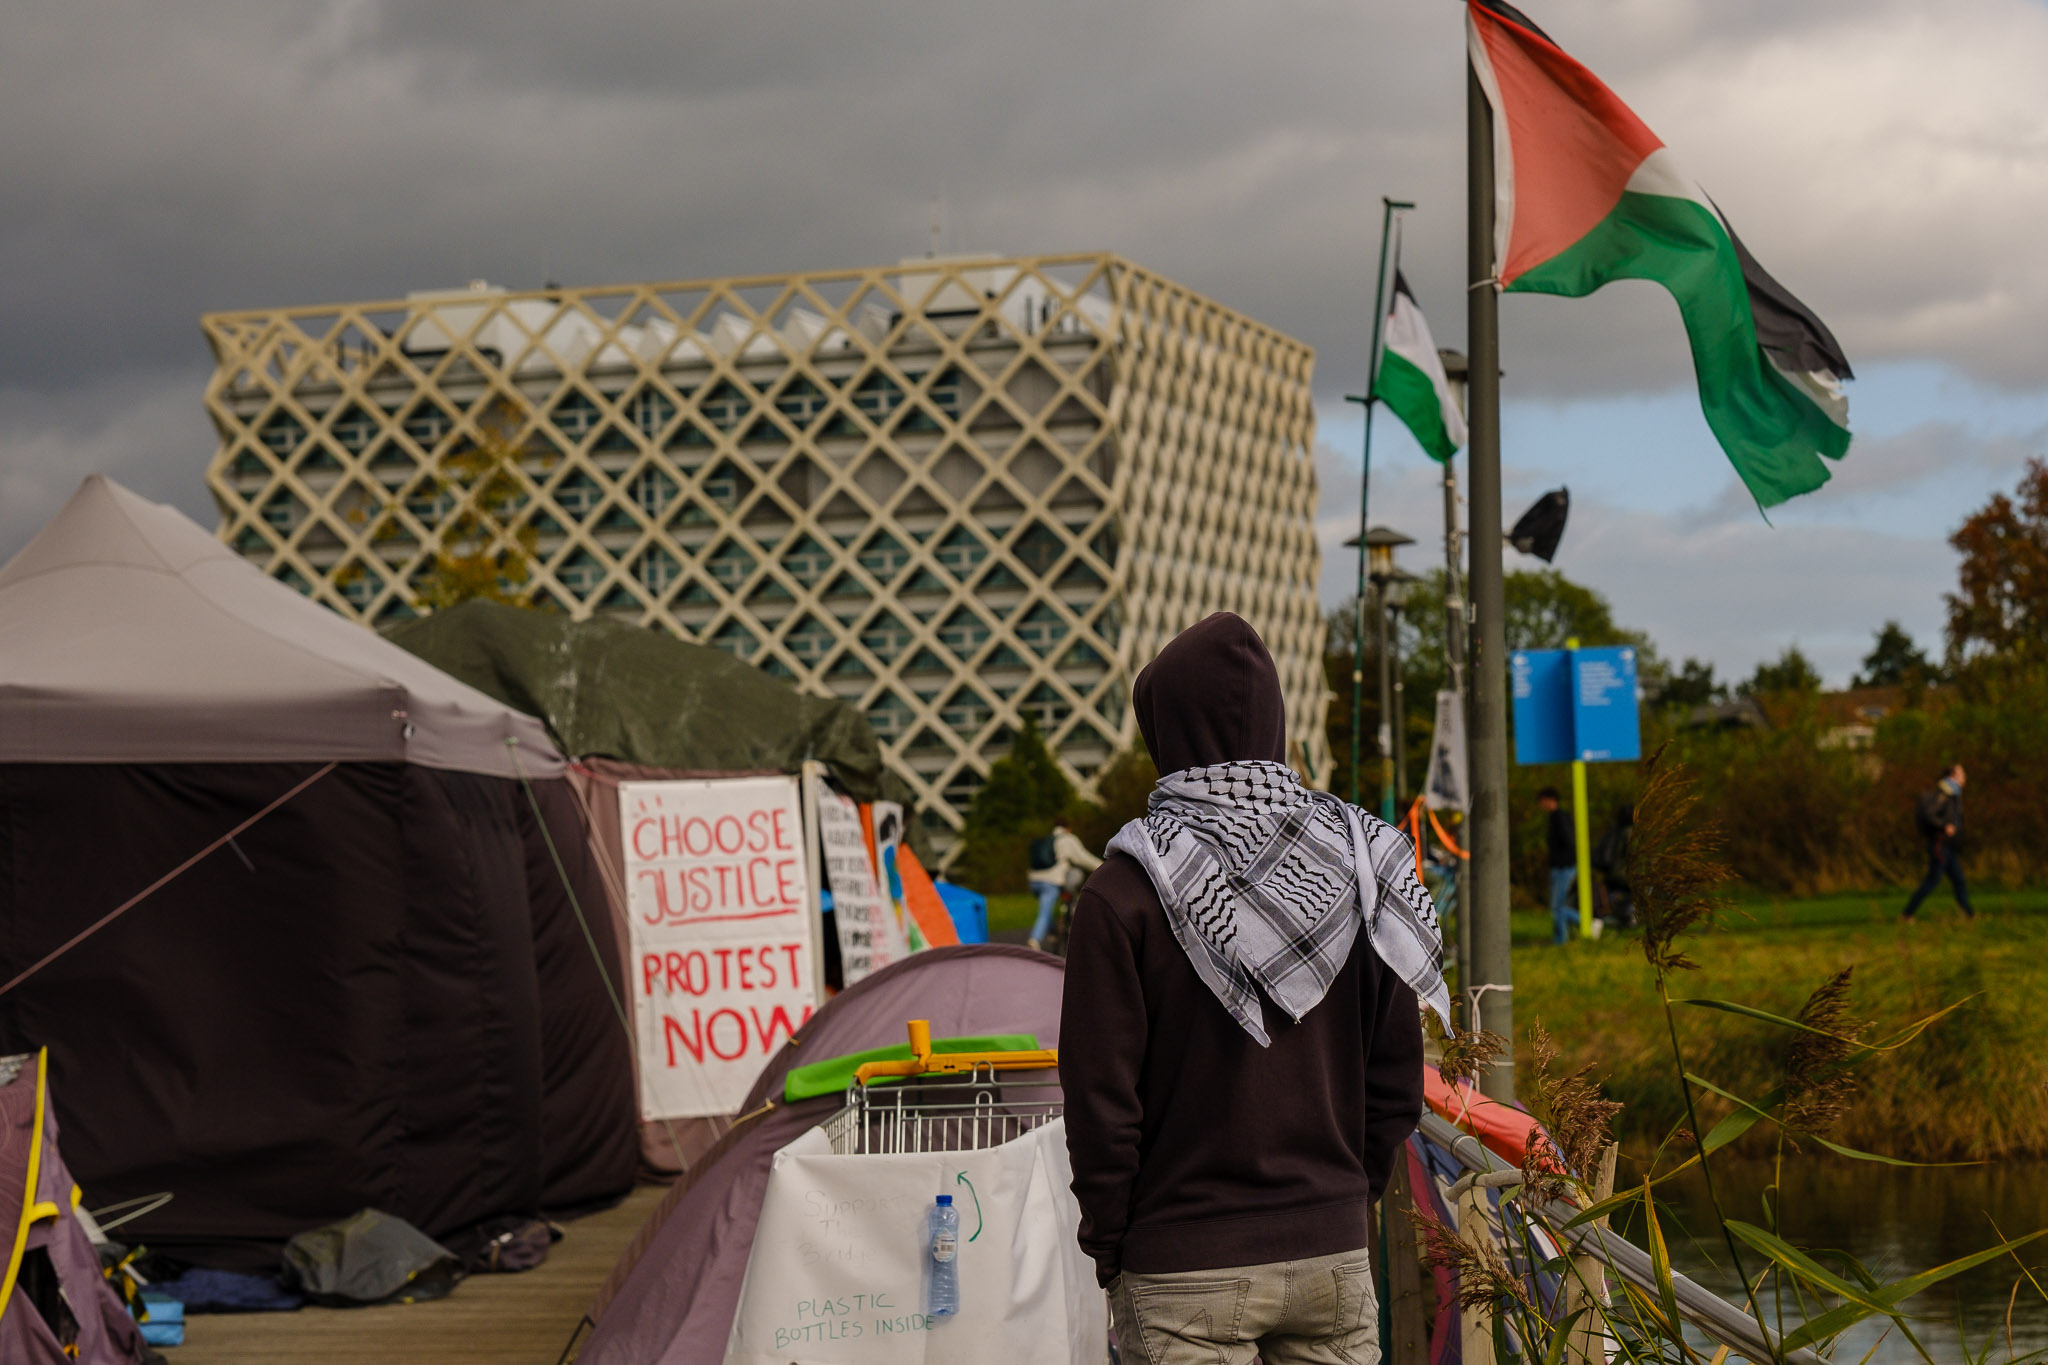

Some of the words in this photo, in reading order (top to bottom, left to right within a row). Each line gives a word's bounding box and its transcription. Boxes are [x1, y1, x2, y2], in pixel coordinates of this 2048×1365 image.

[632, 808, 794, 861] CHOOSE
[638, 858, 799, 926] JUSTICE
[642, 944, 803, 997] PROTEST
[662, 1005, 814, 1068] NOW
[775, 1319, 864, 1349] BOTTLES
[875, 1313, 936, 1336] INSIDE
[797, 1293, 896, 1320] PLASTIC
